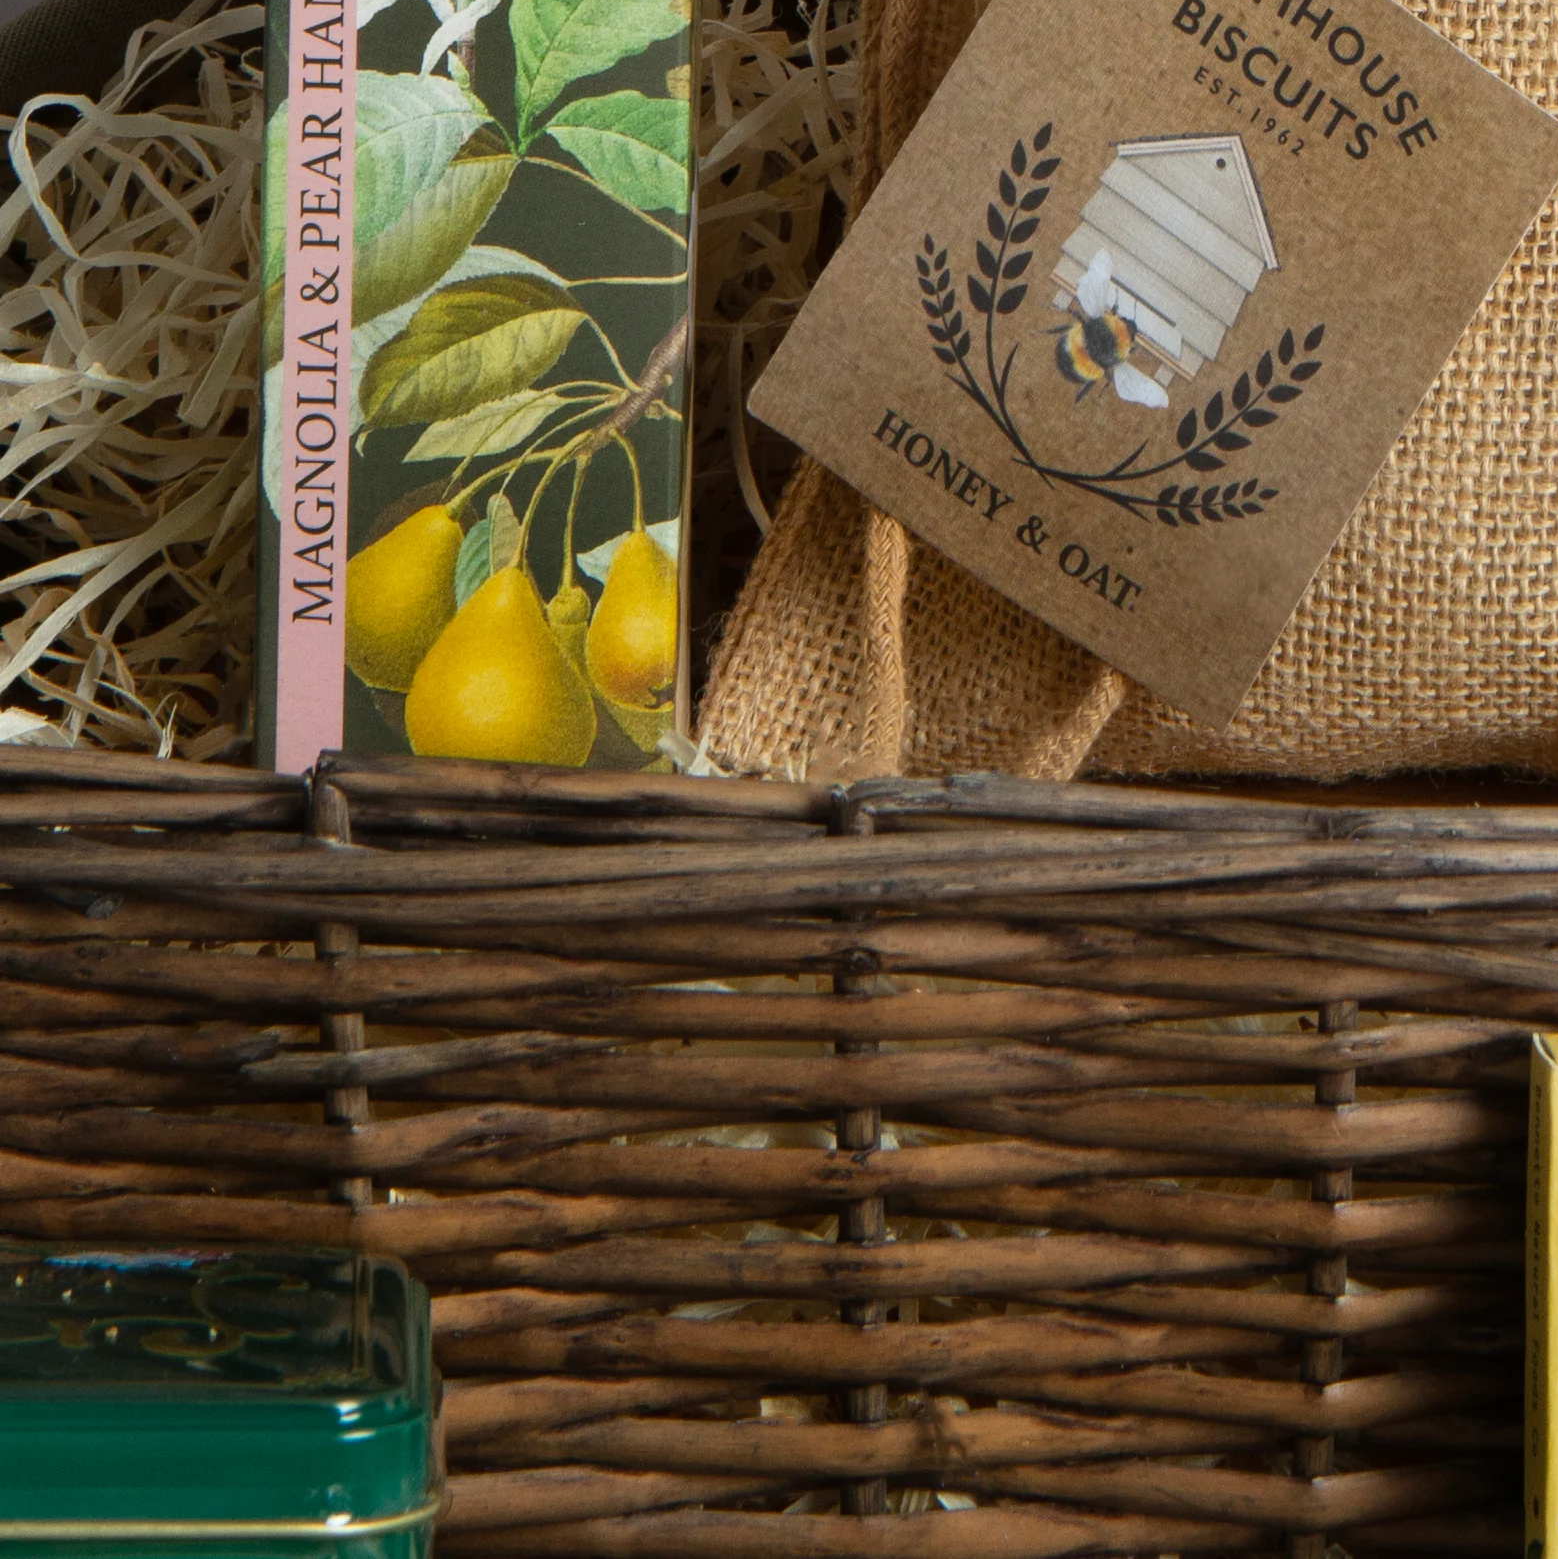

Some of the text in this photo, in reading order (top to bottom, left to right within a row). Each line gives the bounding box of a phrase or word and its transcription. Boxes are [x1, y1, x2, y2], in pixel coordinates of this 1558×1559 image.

[300, 108, 343, 251] PEAR
[300, 266, 340, 305] &
[292, 319, 339, 626] MAGNOLIA
[871, 408, 1015, 522] HONEY
[1016, 514, 1050, 555] &
